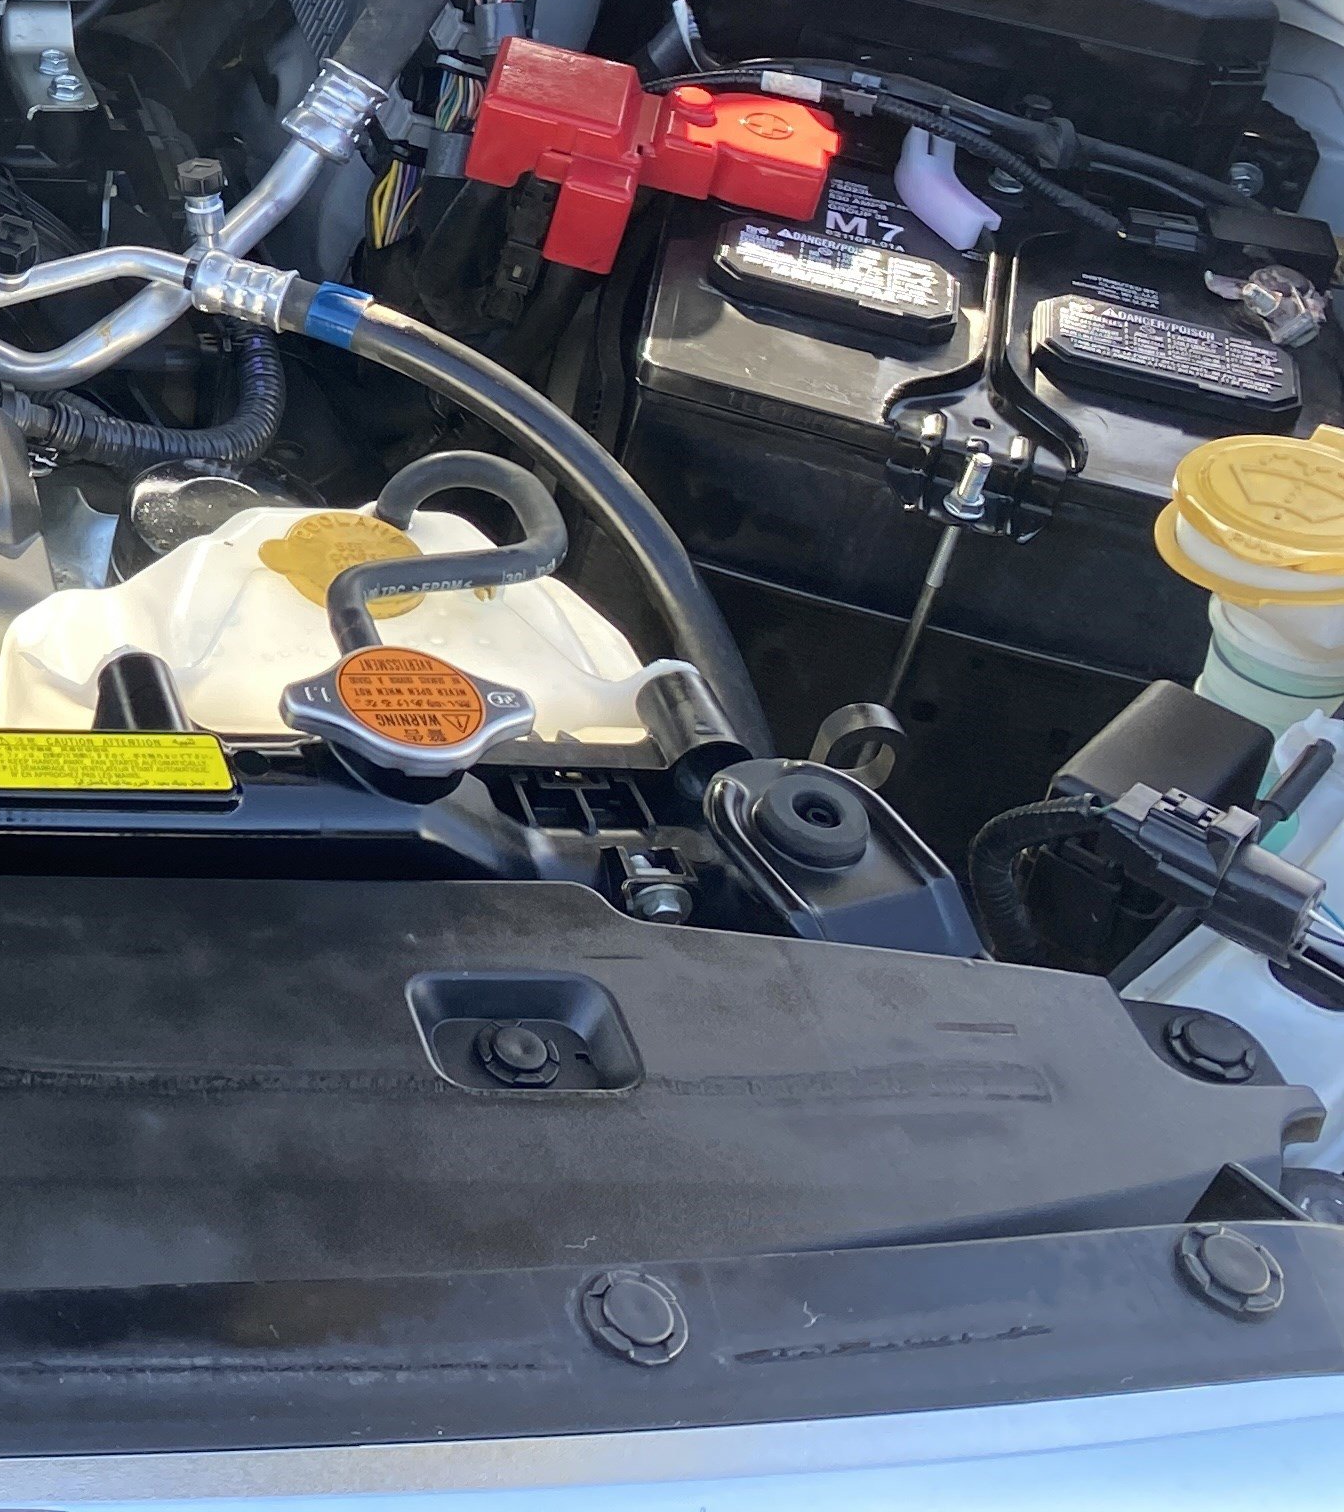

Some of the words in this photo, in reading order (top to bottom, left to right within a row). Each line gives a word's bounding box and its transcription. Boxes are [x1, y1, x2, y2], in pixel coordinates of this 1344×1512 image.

[1117, 310, 1215, 341] DANGER/POISON
[304, 685, 332, 703] 1.1
[377, 687, 405, 696] WHEN
[408, 687, 433, 696] OPEN
[437, 687, 467, 696] NEVER
[375, 712, 441, 728] WARNING
[46, 737, 94, 747] CAUTION
[102, 738, 162, 747] ATTENTION
[403, 729, 446, 743] 警告
